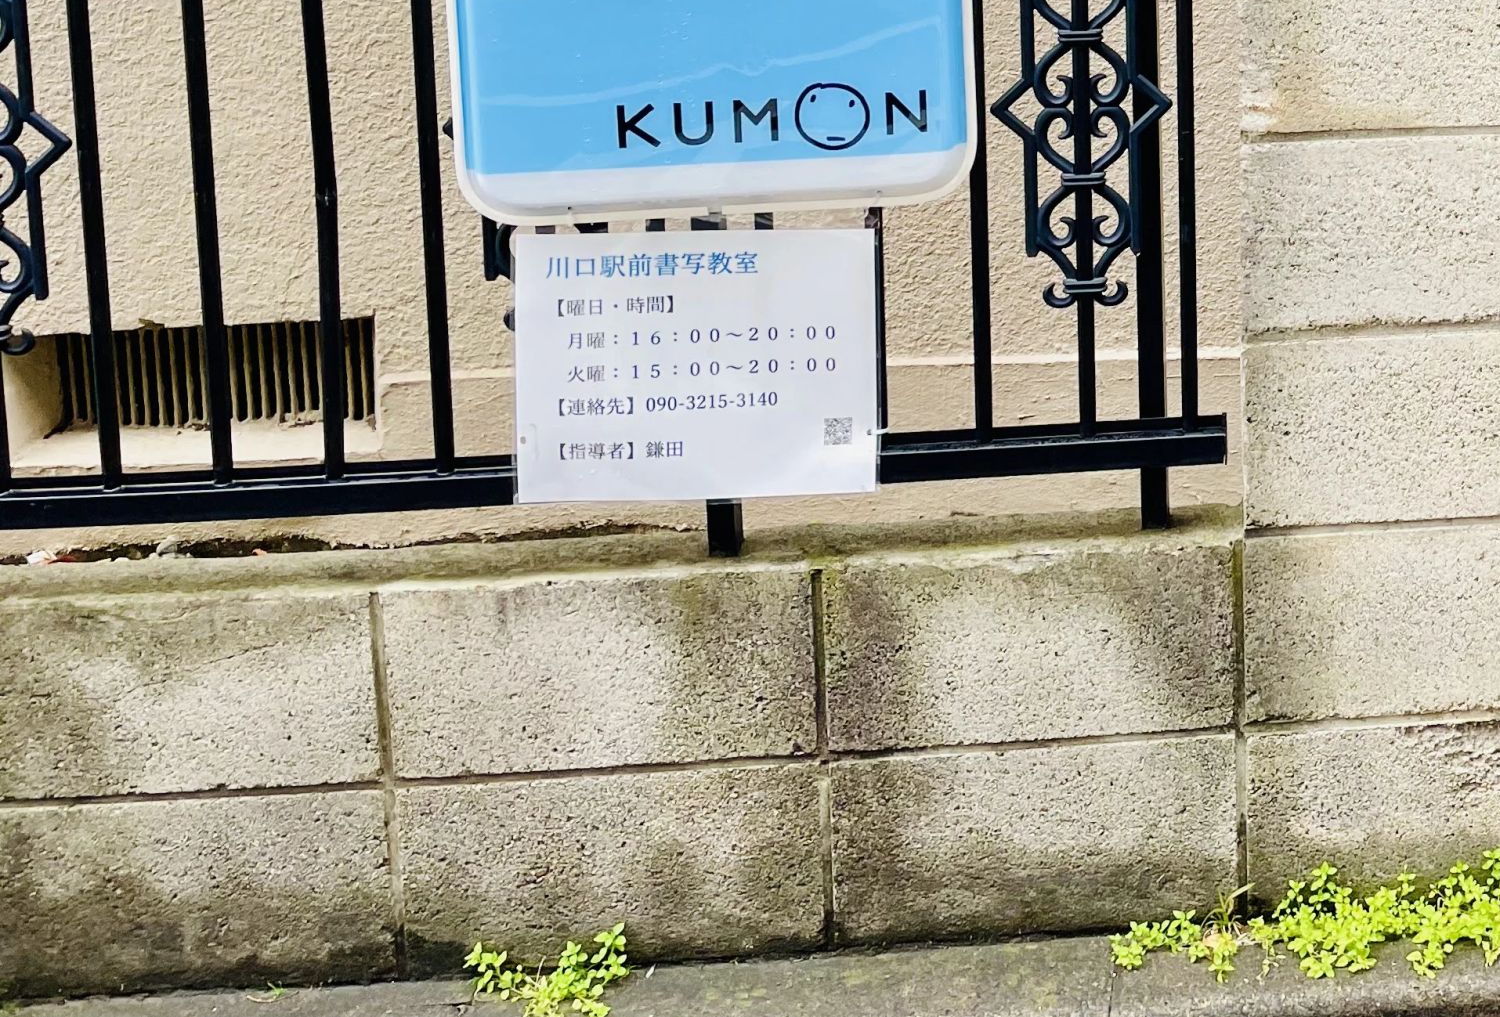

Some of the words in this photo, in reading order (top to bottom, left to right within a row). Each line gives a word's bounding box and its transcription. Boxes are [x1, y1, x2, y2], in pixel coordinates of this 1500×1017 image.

[616, 82, 929, 151] KUMON
[546, 251, 759, 280] 川口駅前書写教室
